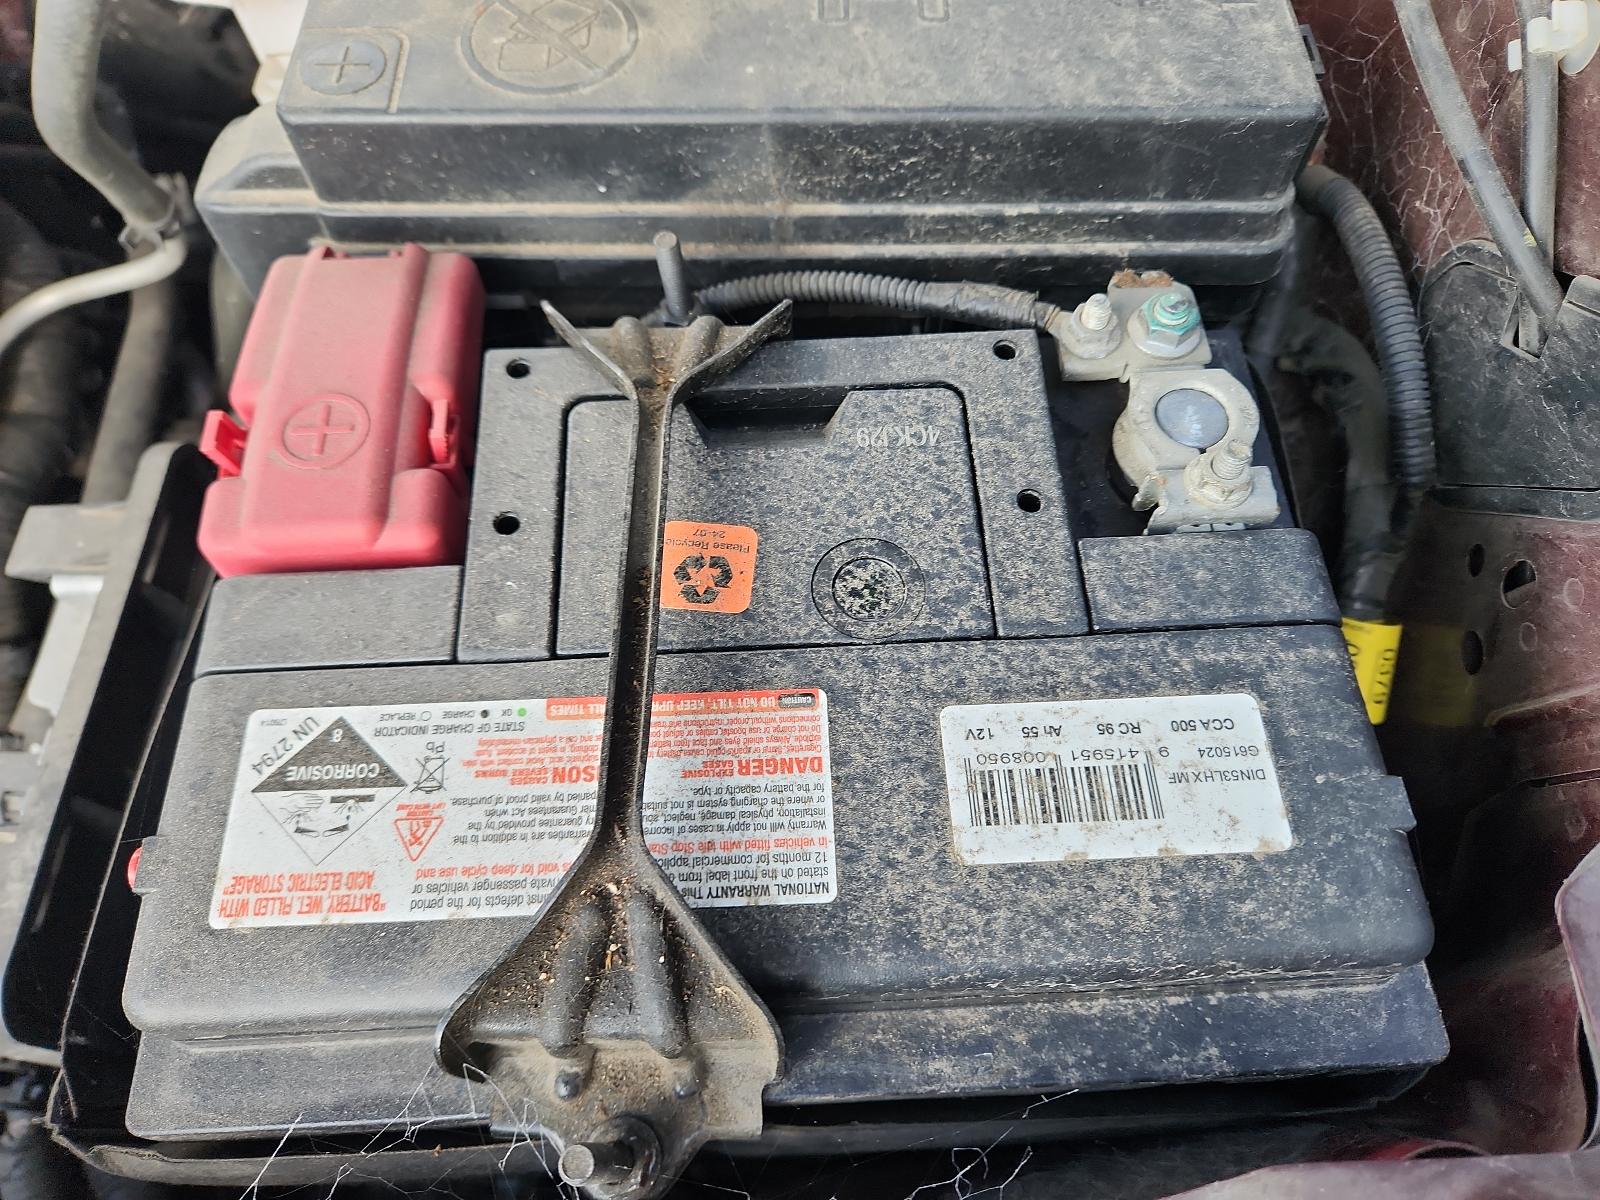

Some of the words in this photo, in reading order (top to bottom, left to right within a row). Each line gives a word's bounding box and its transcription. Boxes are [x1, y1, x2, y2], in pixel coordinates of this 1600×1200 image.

[692, 528, 726, 539] 24-07
[713, 542, 750, 554] Please
[676, 700, 705, 711] KEEP
[736, 697, 757, 709] NOT
[781, 696, 812, 704] CAUTION
[442, 710, 475, 720] CHARGE
[501, 708, 513, 717] OK
[550, 704, 585, 716] TIMES
[378, 712, 416, 722] REPLACE
[291, 716, 320, 741] UN
[432, 723, 474, 735] CHARGE
[477, 722, 491, 733] OF
[494, 721, 526, 732] STATE
[1096, 723, 1115, 735] 95
[1118, 722, 1141, 734] RC
[1170, 719, 1197, 732] 500
[1199, 718, 1235, 730] CCA
[331, 728, 343, 743] 8
[374, 724, 429, 737] INDICATOR
[964, 727, 994, 740] 12V
[1021, 726, 1039, 738] 55
[1043, 725, 1062, 737] Ah
[725, 736, 740, 745] eyes
[425, 741, 446, 754] Pb
[1158, 747, 1170, 758] 9
[1197, 745, 1259, 758] G615024
[251, 737, 294, 776] 2794
[975, 751, 1046, 765] 008950
[1070, 748, 1139, 761] 415951
[702, 760, 734, 769] GASES
[737, 757, 823, 776] DANGER
[284, 762, 380, 782] CORROSIVE
[680, 768, 734, 779] EXPLOSIVE
[1168, 771, 1188, 784] MF
[689, 785, 712, 797] type.
[713, 787, 723, 796] or
[725, 784, 761, 796] capacity
[764, 782, 794, 794] battery
[796, 783, 810, 794] the
[813, 782, 824, 792] for
[494, 794, 503, 807] of
[505, 792, 529, 807] proof
[531, 794, 551, 805] valid
[554, 792, 565, 804] by
[697, 798, 728, 809] system
[730, 796, 768, 808] charging
[770, 797, 784, 807] the
[787, 795, 814, 805] where
[816, 795, 825, 803] or
[528, 805, 577, 816] Guarantees
[642, 801, 667, 812] suitab
[670, 800, 684, 810] not
[687, 800, 694, 810] is
[484, 809, 509, 818] when
[512, 807, 526, 818] Act
[661, 811, 696, 823] neglect,
[698, 810, 736, 821] damage,
[739, 808, 774, 821] physical
[776, 807, 826, 819] installation,
[467, 822, 482, 832] the
[484, 820, 495, 831] by
[498, 818, 536, 831] provided
[539, 816, 582, 830] guarantee
[688, 824, 714, 834] cases
[727, 821, 751, 834] apply
[753, 822, 767, 832] not
[770, 822, 785, 833] will
[787, 820, 826, 833] Warranty
[531, 831, 545, 841] are
[677, 826, 686, 837] of
[716, 826, 725, 835] in
[453, 835, 468, 846] the
[471, 835, 479, 846] to
[482, 833, 517, 844] addition
[519, 833, 528, 843] in
[774, 837, 815, 850] vehicles
[818, 837, 828, 849] in
[671, 841, 695, 855] Stop
[720, 840, 741, 853] with
[745, 839, 770, 852] fitted
[656, 855, 689, 871] applic
[692, 854, 752, 869] commercial
[756, 853, 769, 866] for
[772, 852, 811, 865] months
[814, 851, 827, 864] 12
[416, 868, 436, 880] and
[439, 867, 457, 878] use
[461, 864, 488, 879] cycle
[491, 863, 518, 877] deep
[521, 863, 534, 877] for
[538, 863, 559, 875] void
[761, 869, 777, 881] the
[781, 868, 794, 879] on
[797, 866, 828, 879] stated
[346, 871, 375, 890] ACID
[678, 872, 702, 885] from
[706, 870, 730, 884] label
[733, 869, 758, 882] front
[287, 871, 344, 893] ELECTRIC
[426, 881, 469, 895] vehicles
[471, 877, 527, 892] passenger
[412, 884, 423, 895] or
[681, 886, 704, 899] This
[706, 884, 771, 899] WARRANTY
[774, 882, 829, 896] NATIONAL
[219, 897, 250, 918] WITH
[252, 896, 293, 917] FILLED
[409, 896, 444, 912] period
[447, 897, 464, 910] the
[467, 896, 481, 911] for
[485, 895, 524, 910] defects
